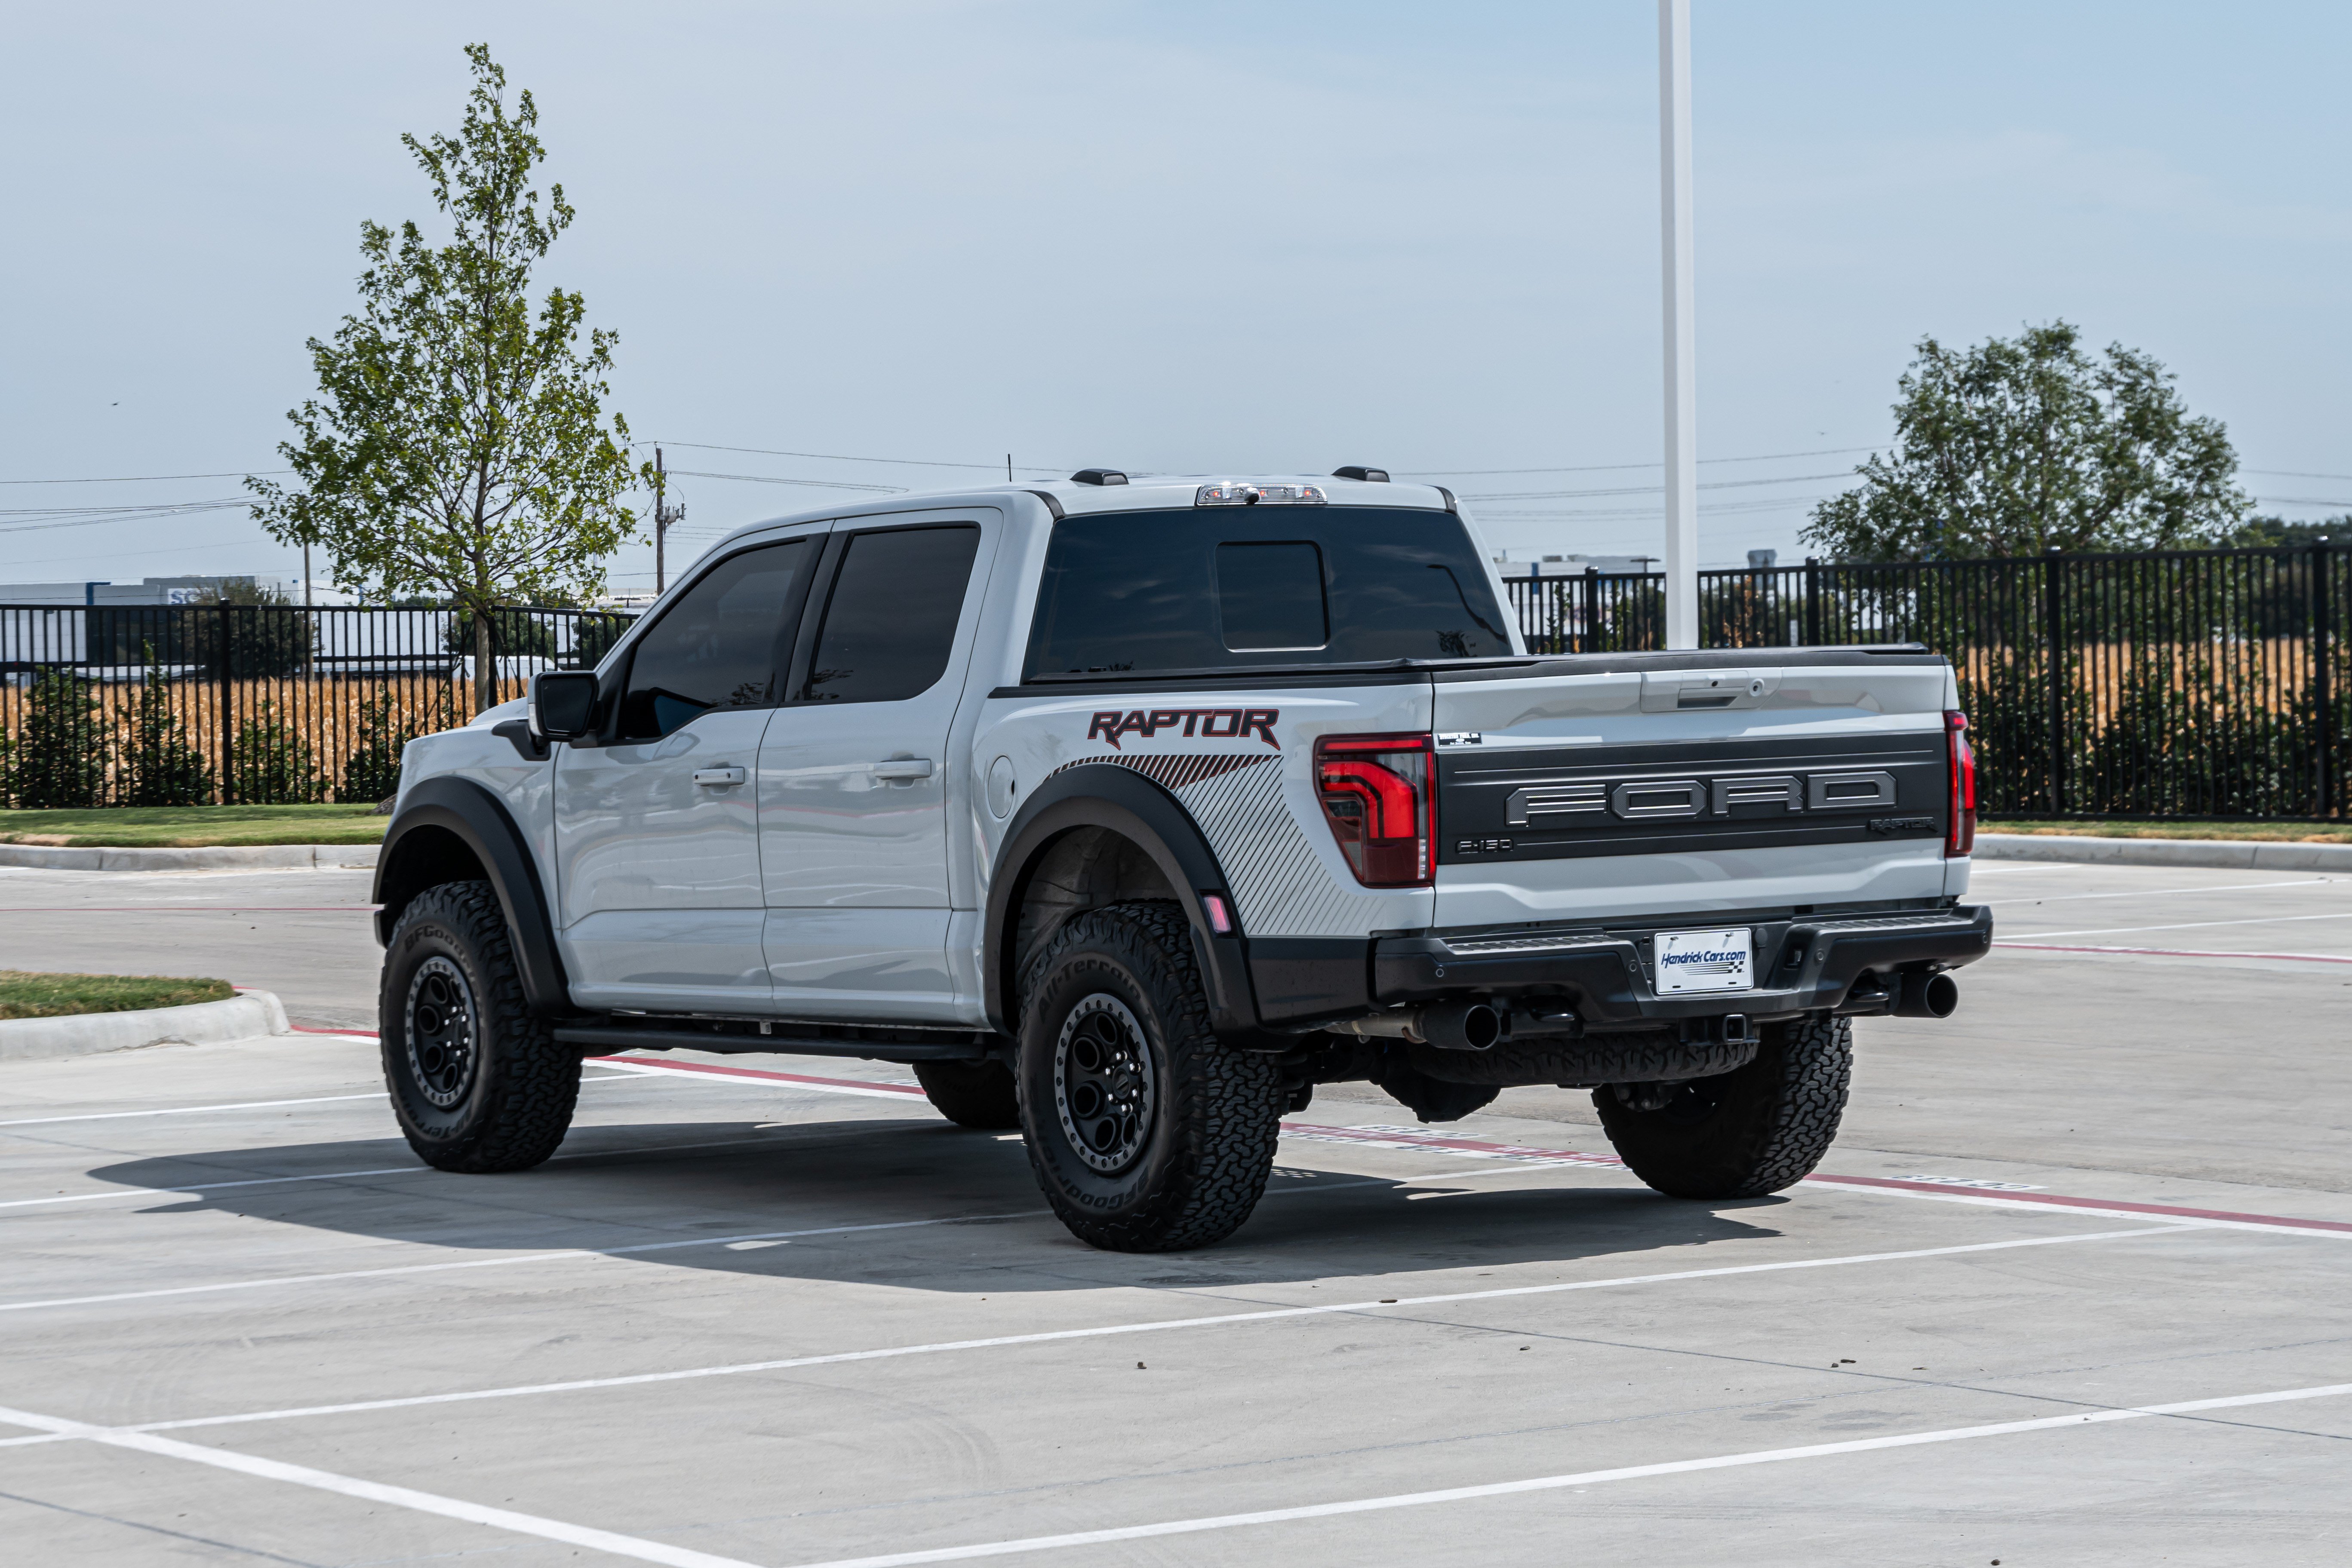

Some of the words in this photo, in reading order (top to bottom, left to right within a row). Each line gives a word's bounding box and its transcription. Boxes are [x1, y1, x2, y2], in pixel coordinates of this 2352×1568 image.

[1087, 708, 1281, 751] RAPTOR
[1505, 770, 1897, 827] FORD
[1457, 839, 1513, 853] F-150
[1869, 817, 1938, 835] RAPTOR
[1037, 958, 1141, 1024] All-Terrain
